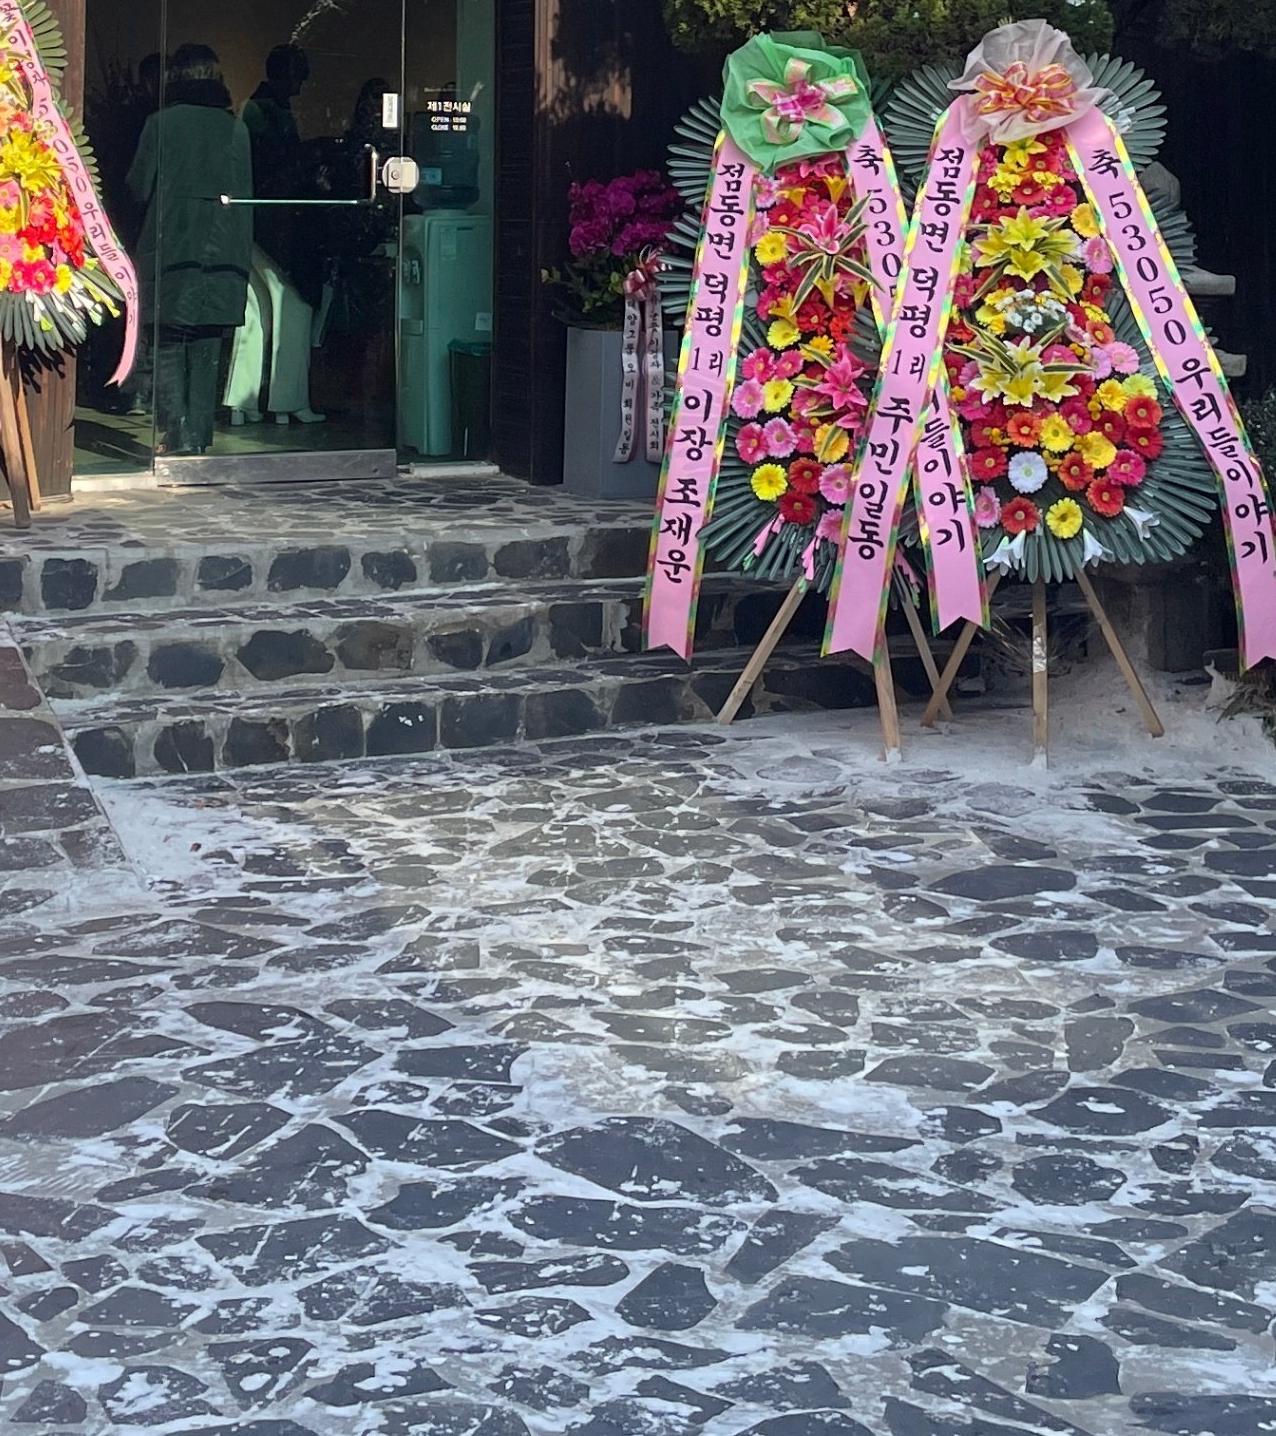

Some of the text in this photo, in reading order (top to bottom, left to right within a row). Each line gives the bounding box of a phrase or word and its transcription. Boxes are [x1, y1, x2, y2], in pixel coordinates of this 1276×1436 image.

[852, 145, 884, 176] 축
[920, 146, 965, 253] 점동면
[707, 163, 745, 261] 점동면
[1089, 149, 1123, 180] 축
[1108, 191, 1187, 346] 53050
[674, 389, 713, 462] 이장
[657, 477, 701, 584] 조재운
